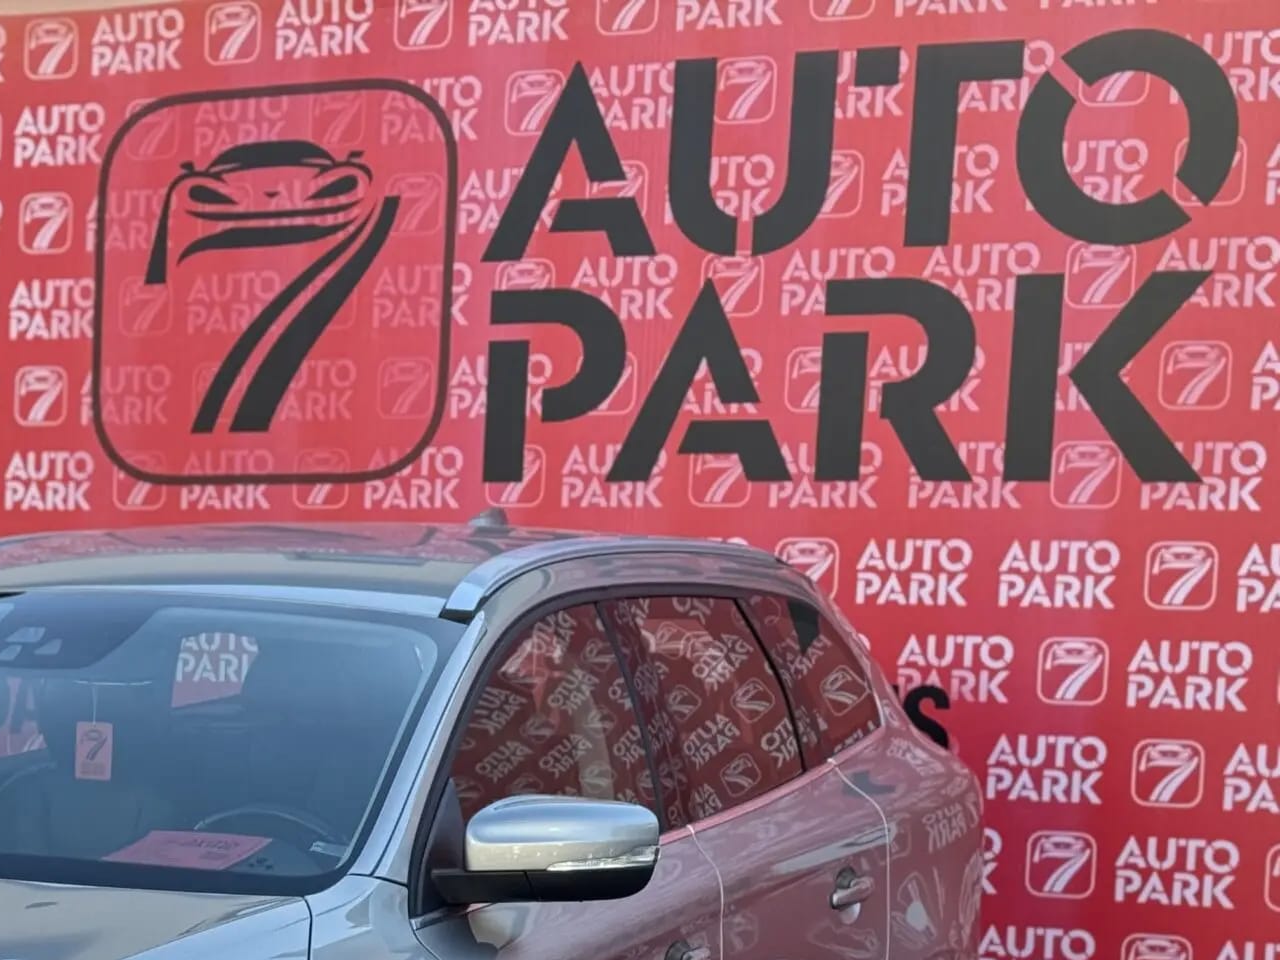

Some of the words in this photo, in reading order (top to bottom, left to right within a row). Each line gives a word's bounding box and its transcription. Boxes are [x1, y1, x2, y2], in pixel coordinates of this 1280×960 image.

[91, 8, 184, 44] AUTO
[468, 8, 570, 47] PARK
[676, 0, 783, 32] PARK
[275, 21, 371, 60] PARK
[91, 39, 182, 77] PARK
[14, 103, 104, 137] AUTO
[14, 134, 101, 167] PARK
[480, 28, 1240, 262] AUTO
[782, 246, 895, 282] AUTO
[923, 242, 1040, 278] AUTO
[1156, 236, 1280, 271] AUTO
[572, 254, 678, 288] AUTO
[9, 278, 94, 309] AUTO
[10, 309, 93, 340] PARK
[483, 269, 1214, 483] PARK
[279, 391, 354, 421] ARK
[5, 452, 93, 480] AUTO
[5, 479, 90, 510] PARK
[180, 482, 270, 510] PARK
[363, 476, 460, 511] PARK
[561, 476, 663, 509] PARK
[769, 476, 878, 509] PARK
[908, 476, 1022, 509] PARK
[1140, 477, 1263, 512] PARK
[857, 539, 972, 572] AUTO
[999, 540, 1120, 573] AUTO
[856, 572, 967, 606] PARK
[999, 573, 1115, 608] PARK
[897, 635, 1014, 669] AUTO
[1128, 640, 1252, 676] AUTO
[1127, 674, 1248, 711] PARK
[988, 735, 1107, 769] AUTO
[987, 767, 1102, 804] PARK
[1116, 837, 1239, 874] AUTO
[1115, 869, 1234, 909] PARK
